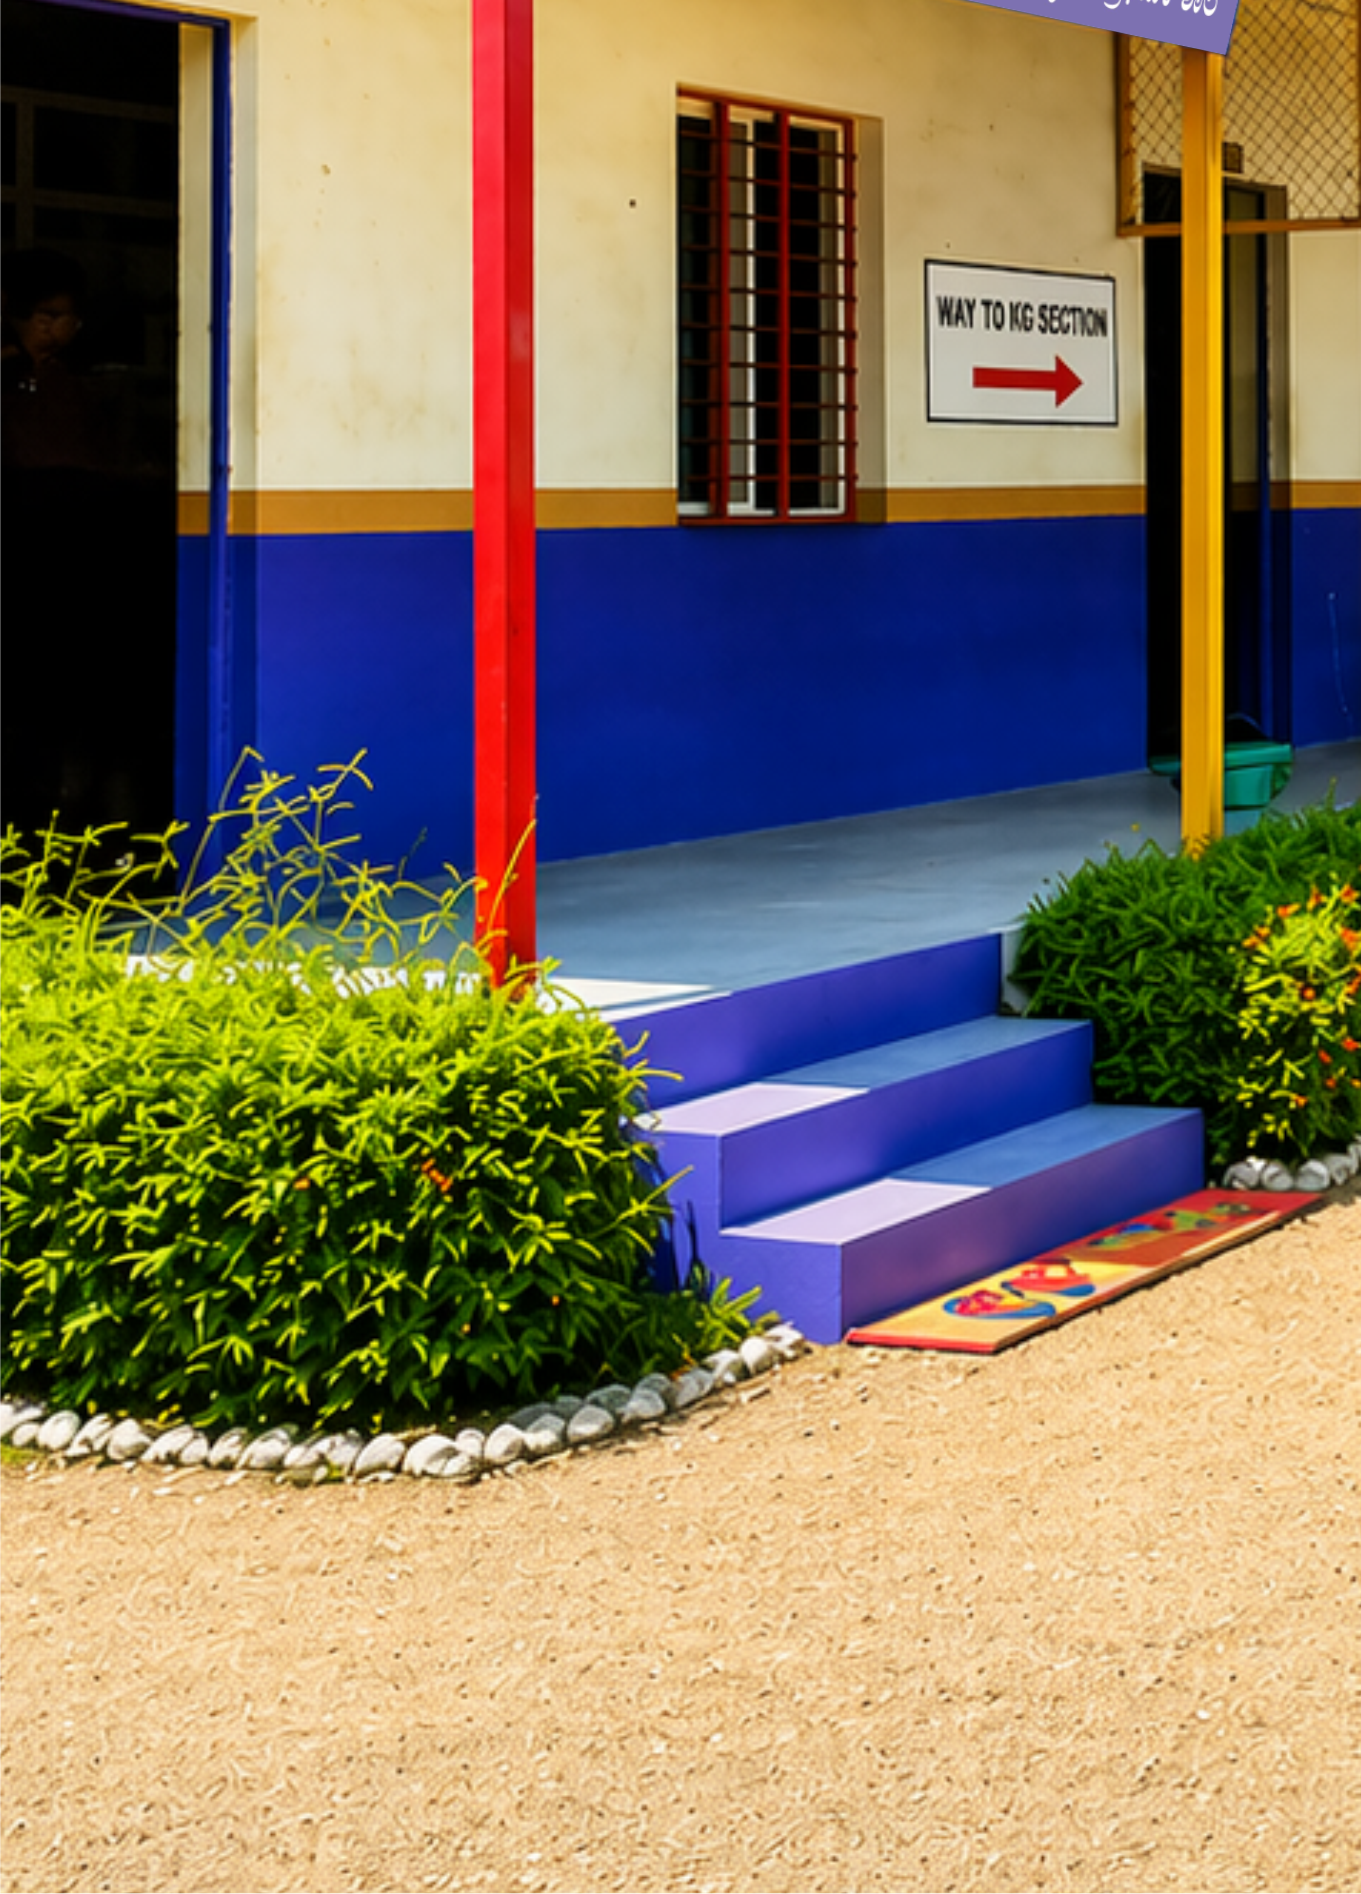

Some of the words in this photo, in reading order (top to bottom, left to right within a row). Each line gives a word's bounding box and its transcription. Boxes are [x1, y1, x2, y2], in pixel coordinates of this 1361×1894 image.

[936, 296, 976, 329] WAY
[981, 298, 1005, 332] TO
[1009, 301, 1034, 333] KG
[1037, 304, 1108, 338] SECTION
